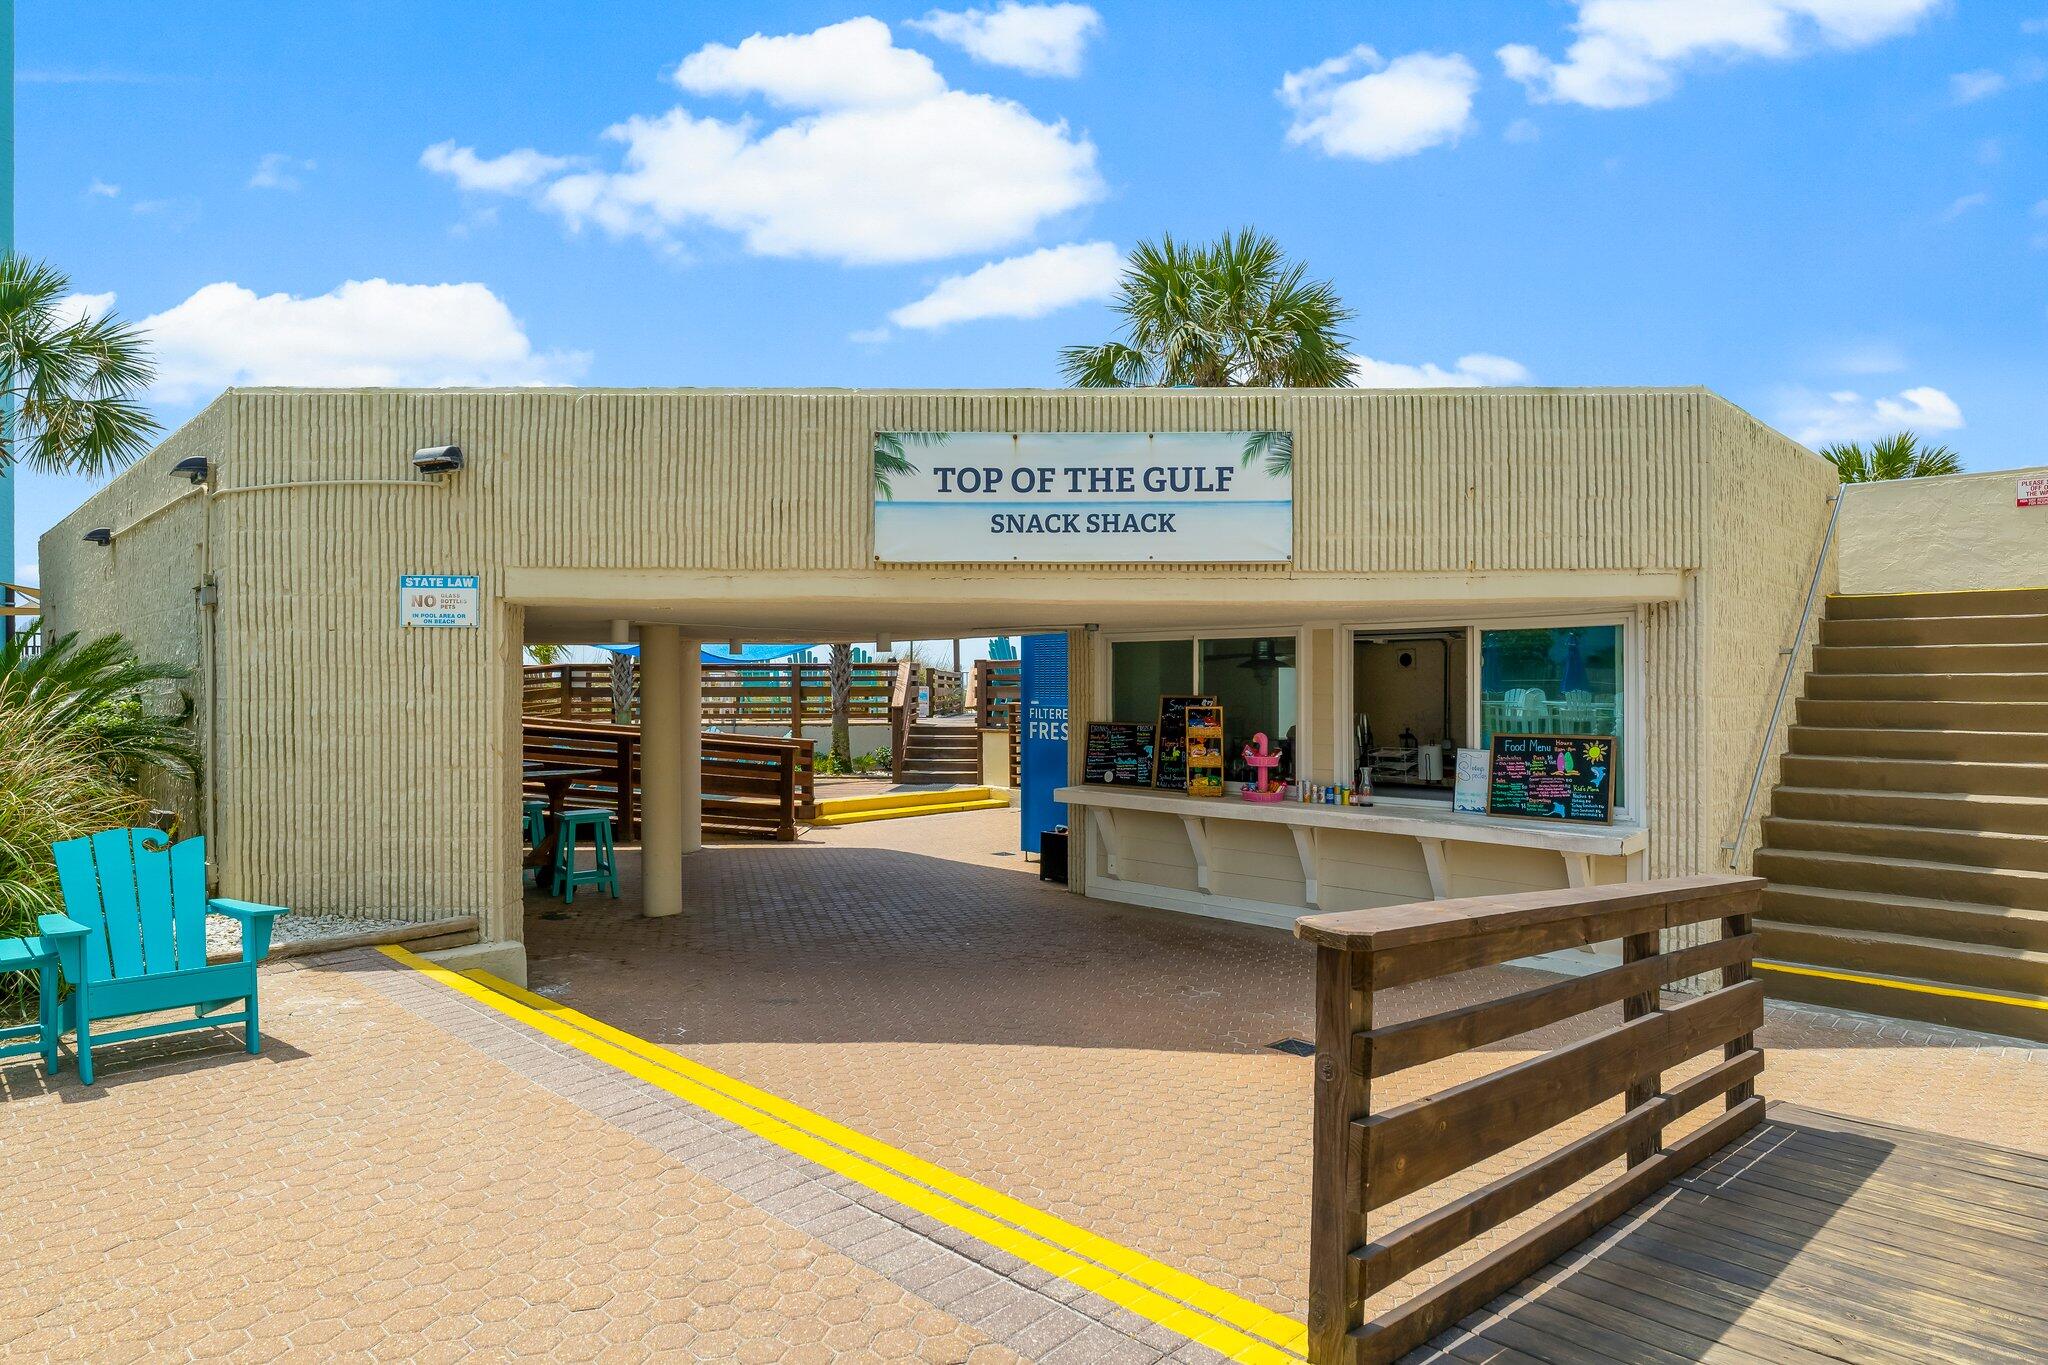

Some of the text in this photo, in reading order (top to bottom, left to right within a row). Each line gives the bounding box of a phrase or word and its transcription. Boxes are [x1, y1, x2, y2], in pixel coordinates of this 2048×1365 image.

[933, 466, 1234, 493] TOP OF THE GULF
[990, 513, 1176, 533] SNACK SHACK
[405, 577, 474, 587] STATE LAW
[411, 594, 437, 608] NO
[1029, 707, 1069, 720] FILTERE
[1029, 721, 1069, 741] FRES
[1504, 739, 1526, 752] Food
[1529, 739, 1552, 752] Menu
